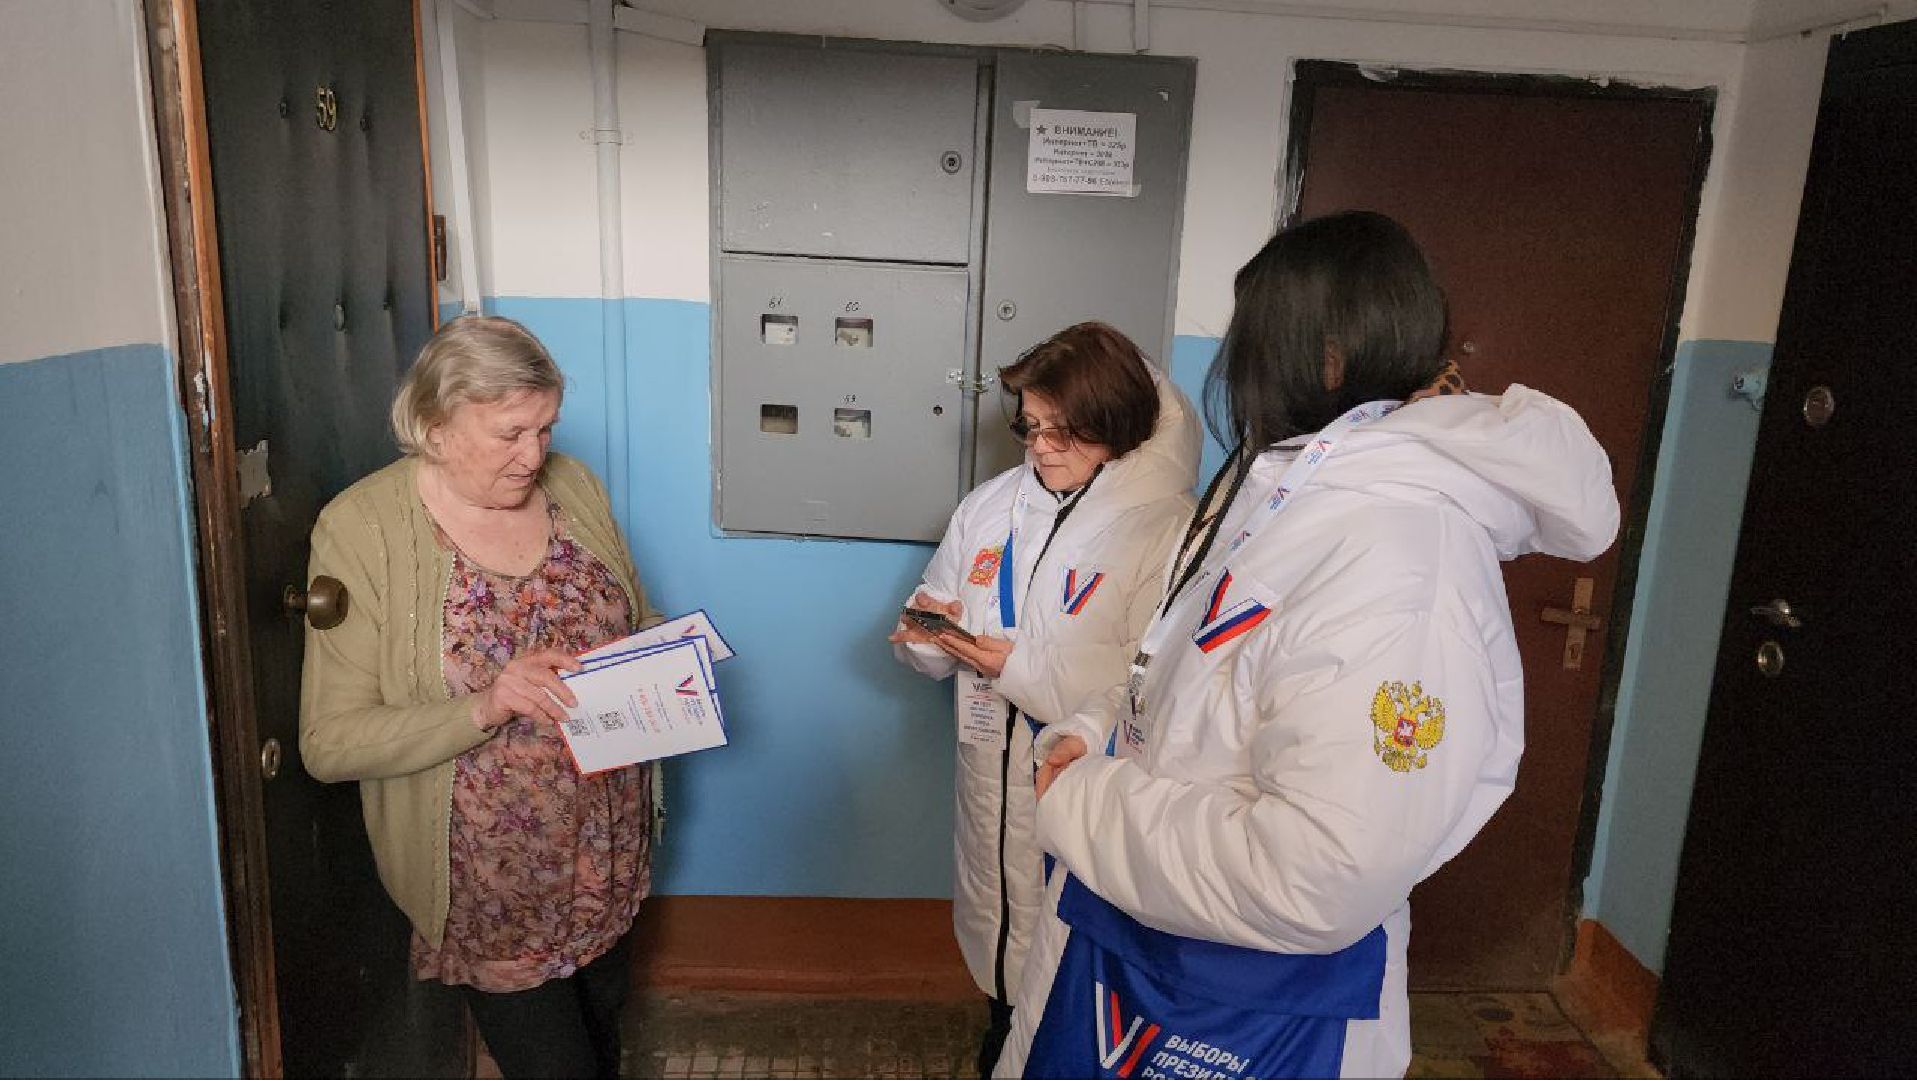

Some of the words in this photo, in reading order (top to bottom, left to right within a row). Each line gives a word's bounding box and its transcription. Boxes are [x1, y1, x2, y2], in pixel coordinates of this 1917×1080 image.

[317, 87, 336, 130] 59
[1055, 126, 1117, 138] ВНИМАНИЕ!
[1151, 1051, 1234, 1080] ПРЕЗИД
[1165, 1035, 1250, 1074] ВЫБОРЫ
